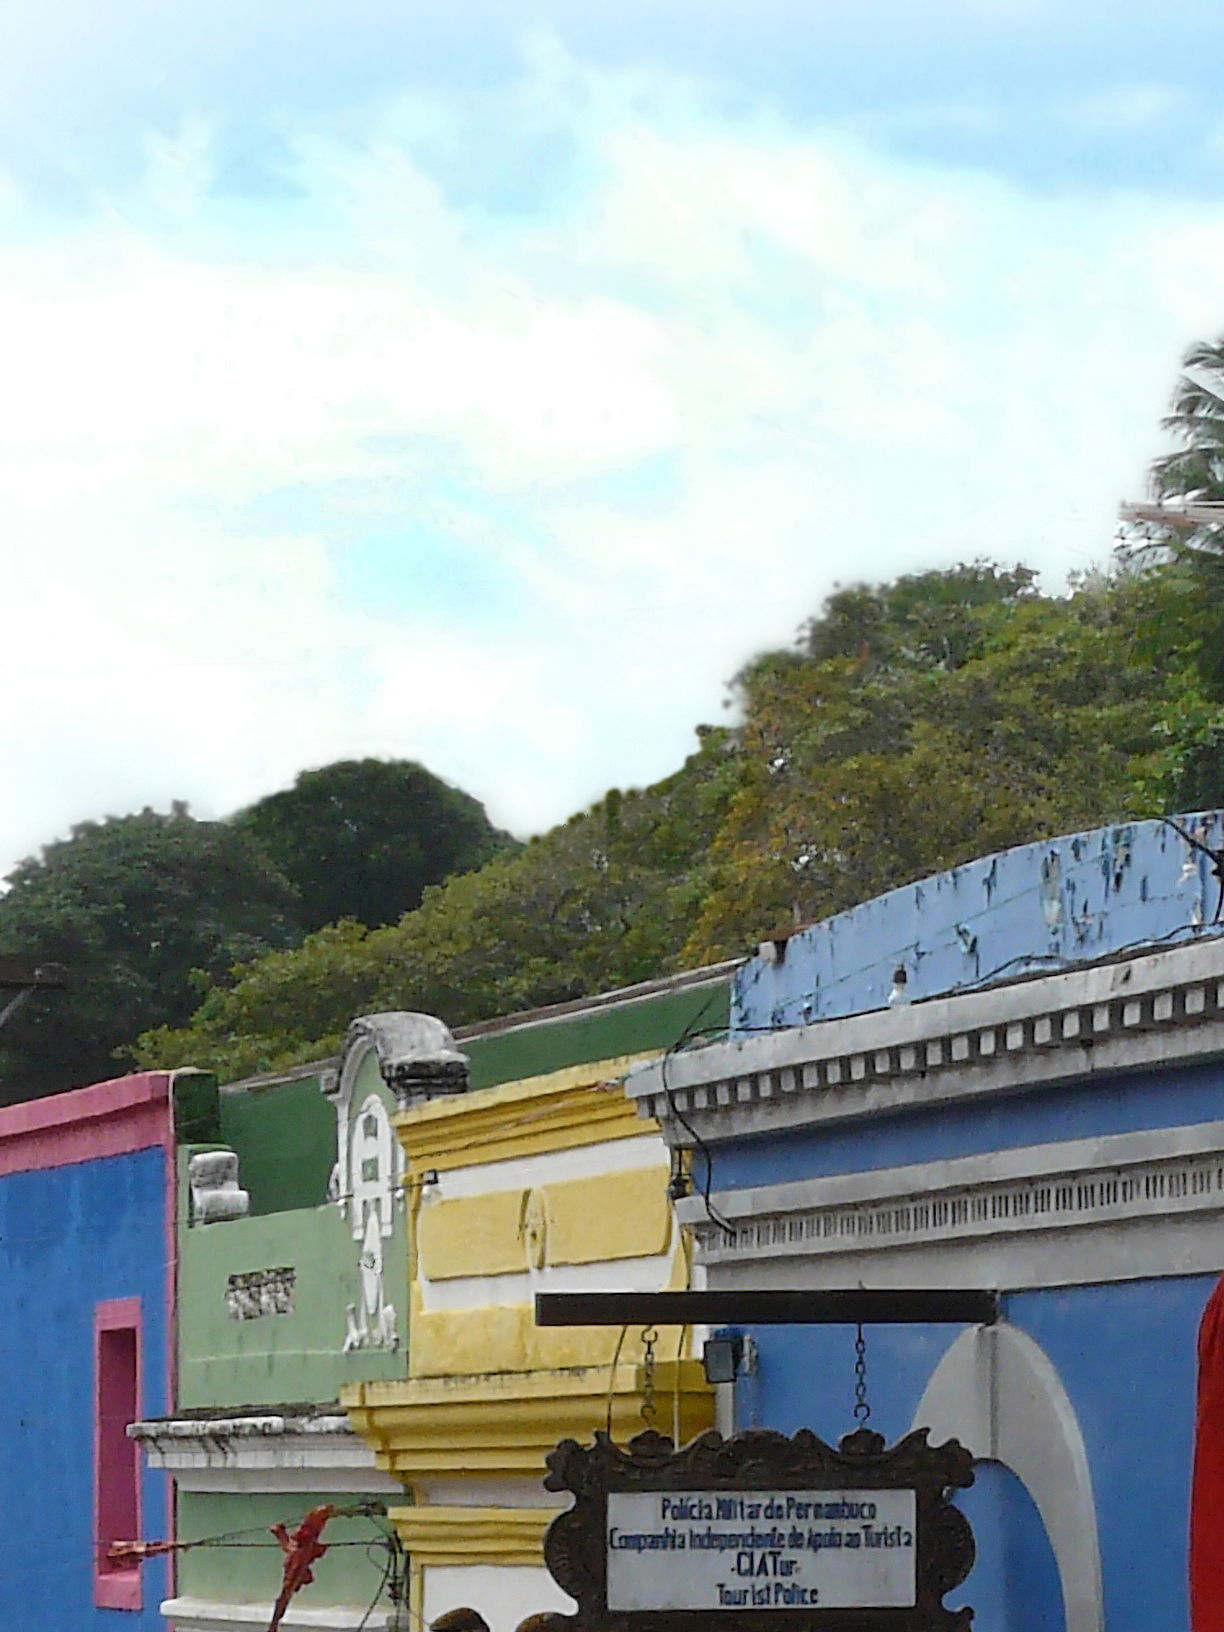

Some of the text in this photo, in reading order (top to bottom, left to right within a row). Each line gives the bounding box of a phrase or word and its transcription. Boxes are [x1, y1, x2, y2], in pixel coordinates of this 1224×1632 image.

[661, 1496, 877, 1521] Polícia Militar de Pernambuco
[609, 1524, 913, 1553] Companhia Independente de Apoio ao Turista
[716, 1583, 819, 1606] Tourist Police
